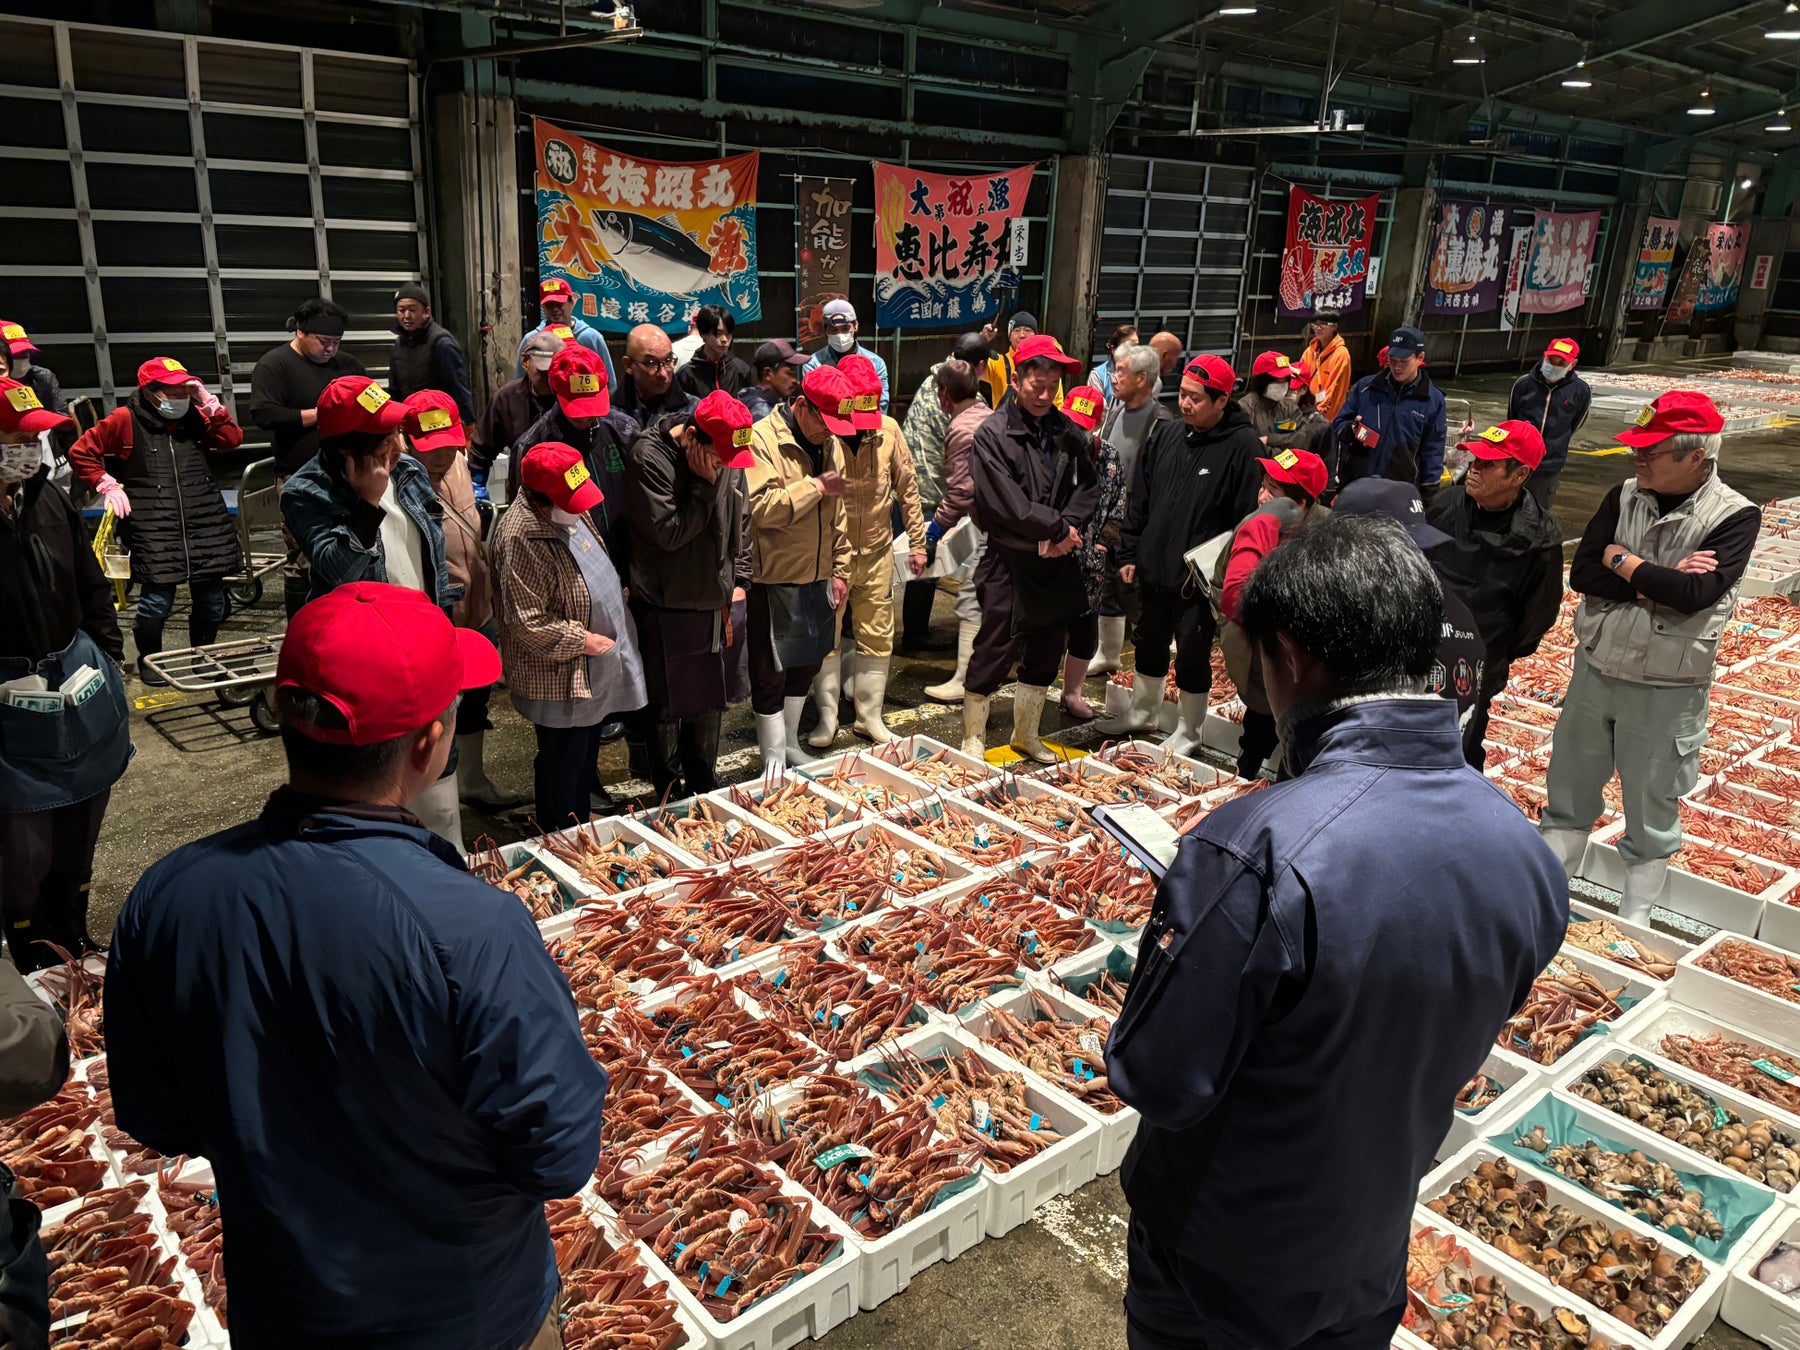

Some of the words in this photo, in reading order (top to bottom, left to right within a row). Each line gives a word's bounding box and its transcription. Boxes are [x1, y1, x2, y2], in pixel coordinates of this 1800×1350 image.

[548, 141, 572, 179] 祝
[599, 154, 735, 209] 梅昭丸
[910, 179, 932, 216] 大
[551, 205, 602, 274] 大
[17, 387, 33, 400] 51
[578, 375, 591, 385] 76
[862, 396, 873, 405] 20
